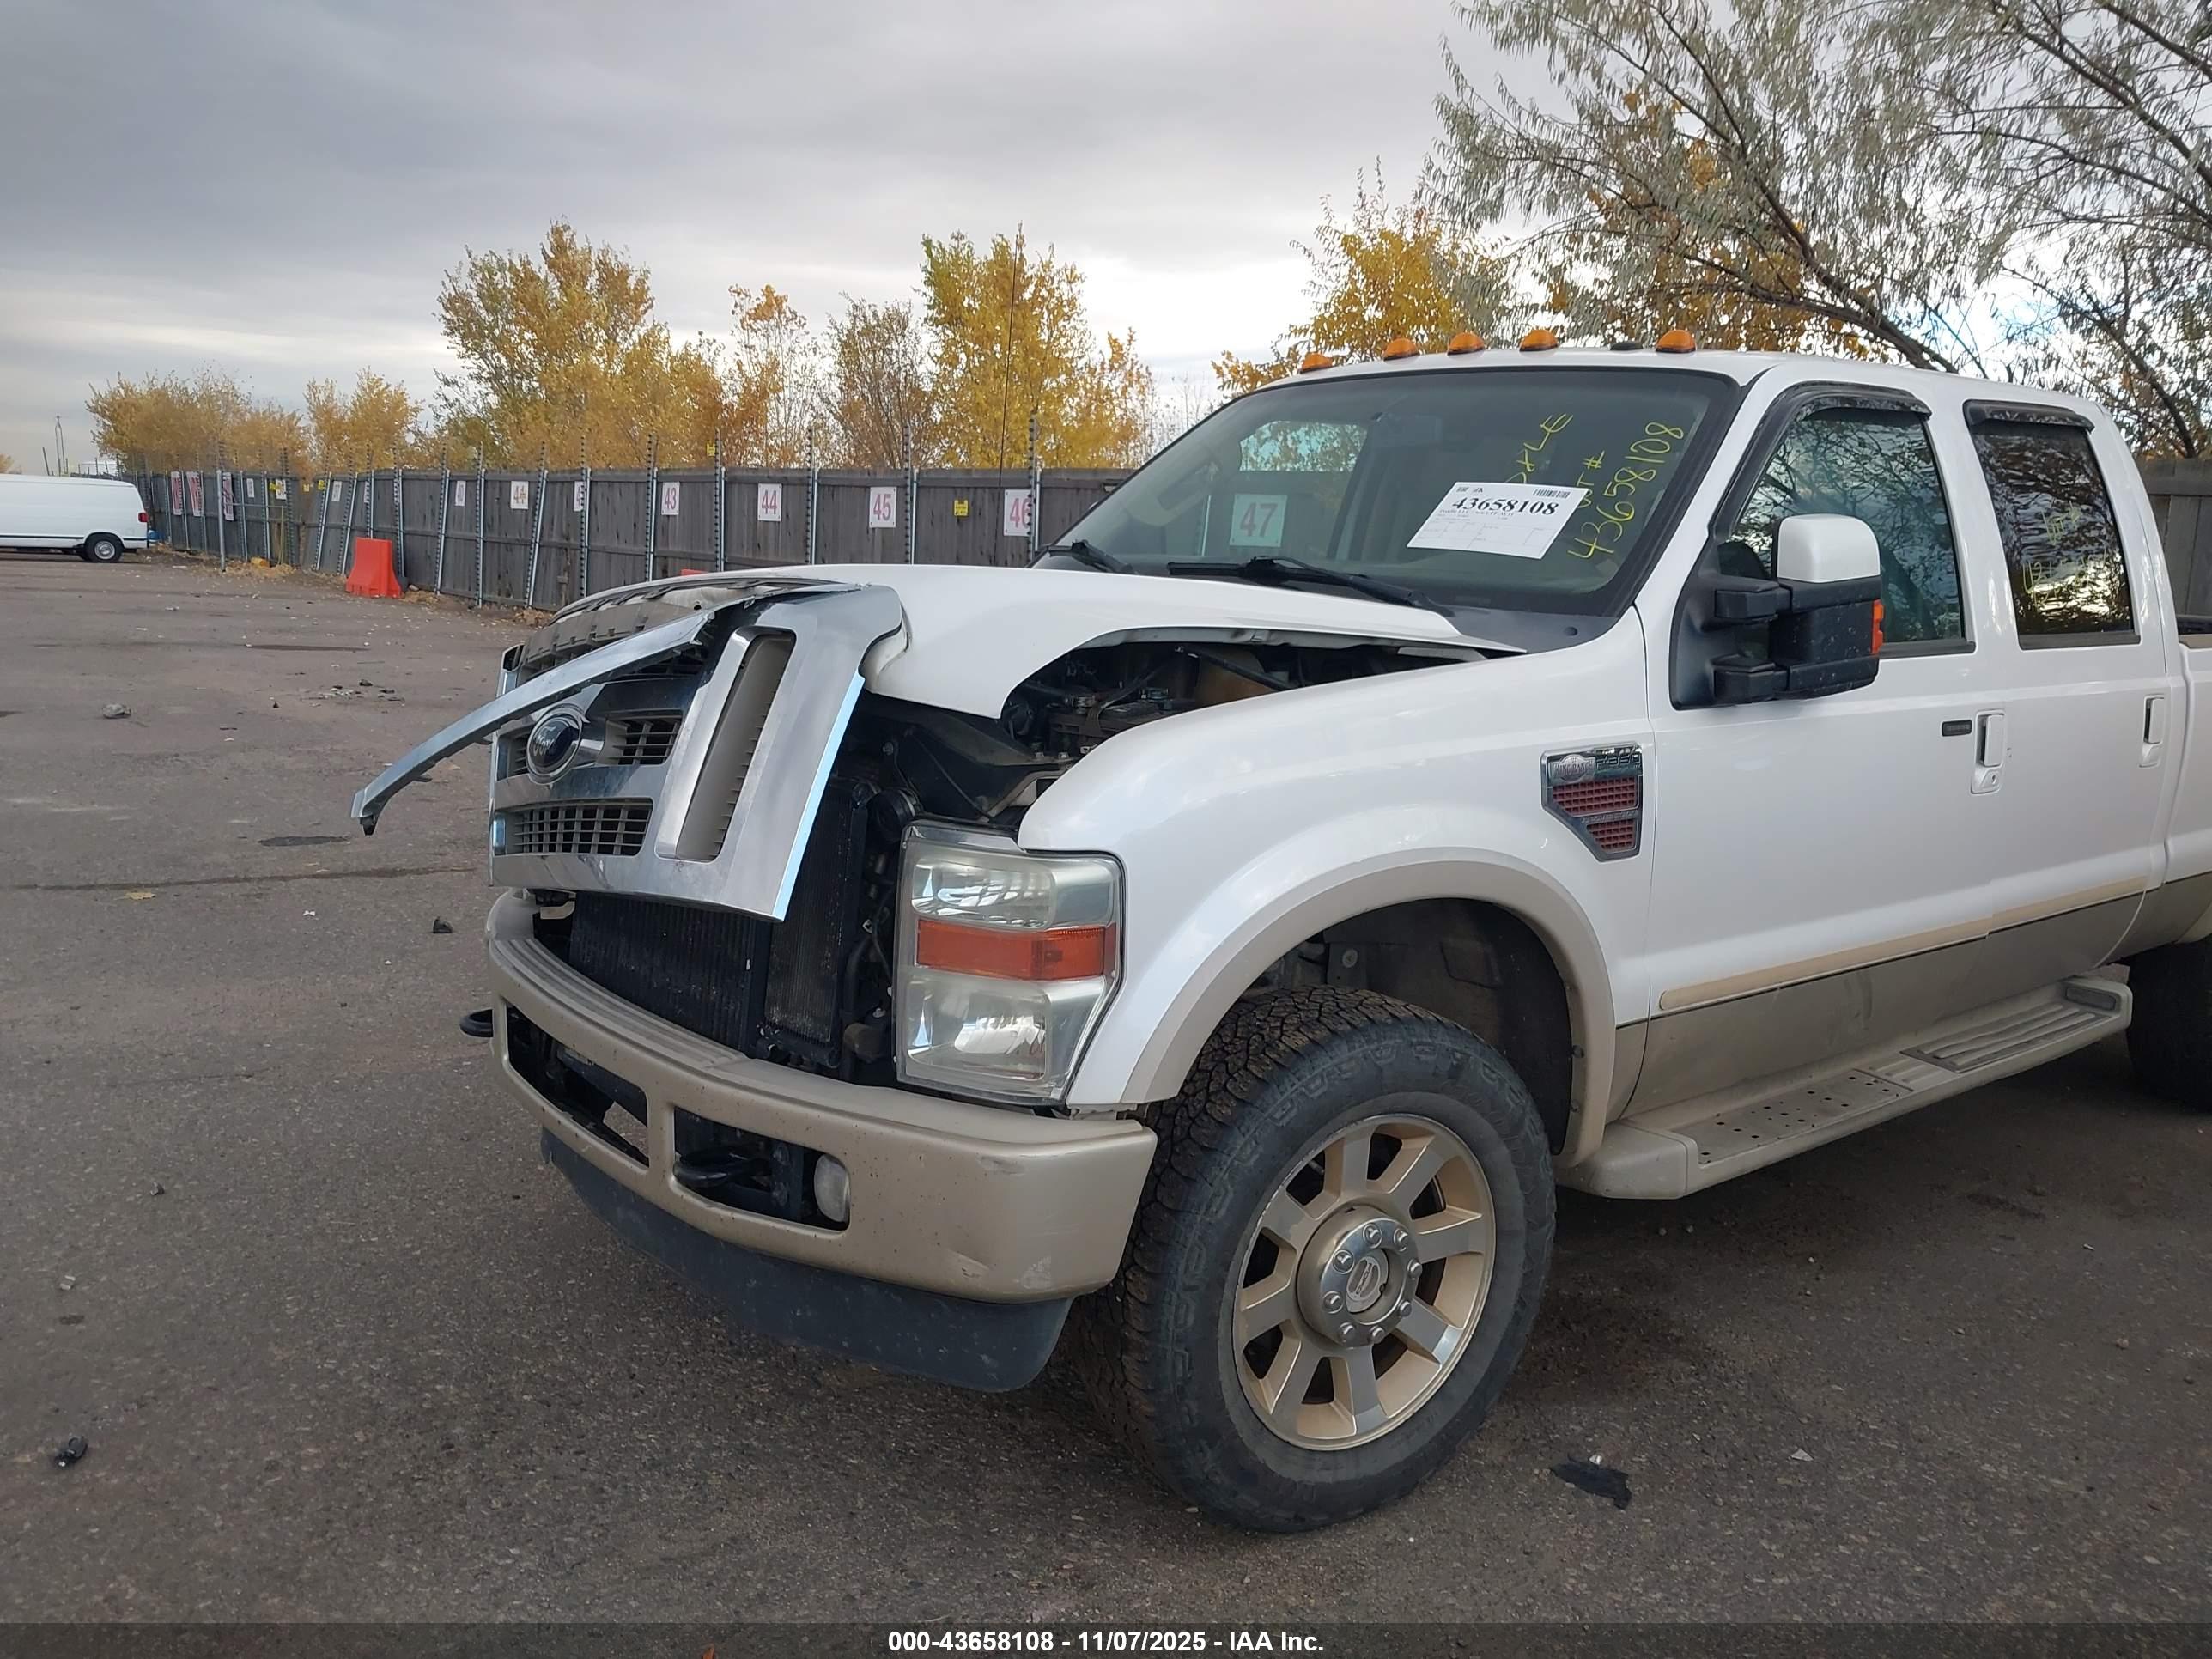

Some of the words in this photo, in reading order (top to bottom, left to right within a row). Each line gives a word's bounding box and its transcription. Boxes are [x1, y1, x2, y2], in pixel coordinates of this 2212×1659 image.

[664, 487, 677, 510] 43
[761, 489, 777, 514] 44
[1567, 422, 1684, 559] 43658108
[873, 494, 891, 520] 45
[1452, 496, 1559, 515] 43658108
[1239, 502, 1278, 538] 47
